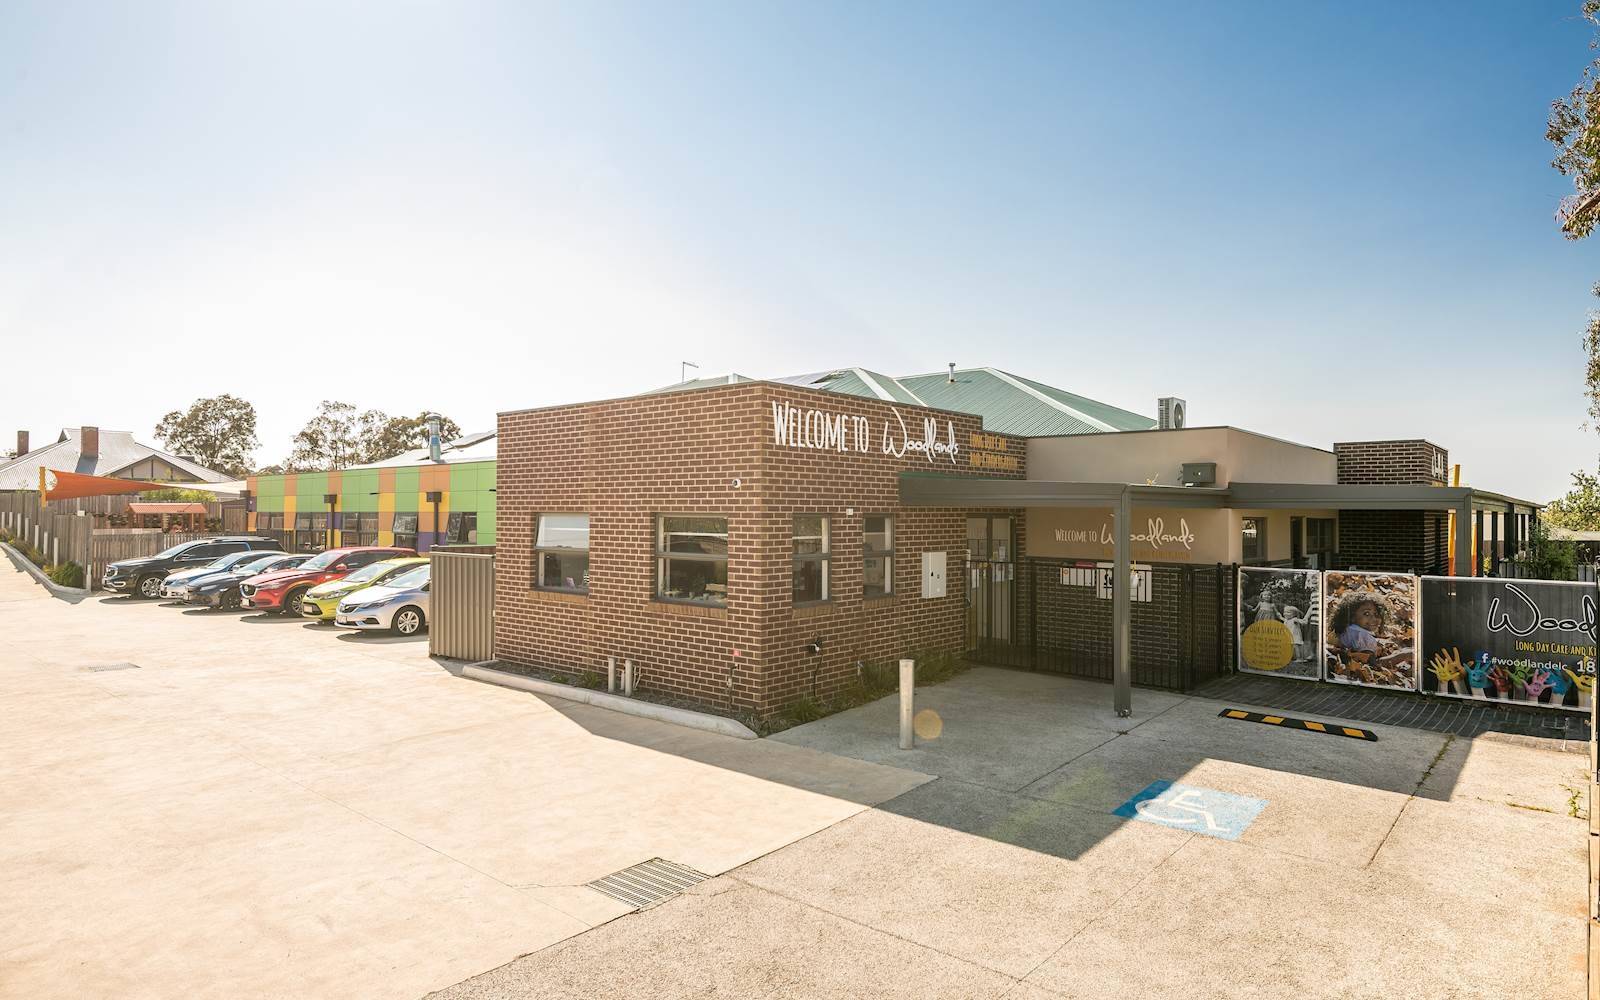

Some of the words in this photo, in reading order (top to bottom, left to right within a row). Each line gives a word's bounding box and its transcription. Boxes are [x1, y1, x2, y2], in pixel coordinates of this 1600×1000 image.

[772, 401, 848, 452] WELCOME
[852, 417, 870, 453] TO
[882, 406, 959, 464] Woodlands
[1055, 528, 1087, 543] WELCOME
[1088, 529, 1097, 543] TO
[1515, 640, 1535, 652] LONG
[1536, 641, 1550, 653] DAY
[1551, 642, 1569, 655] CARE
[1570, 645, 1586, 656] AND
